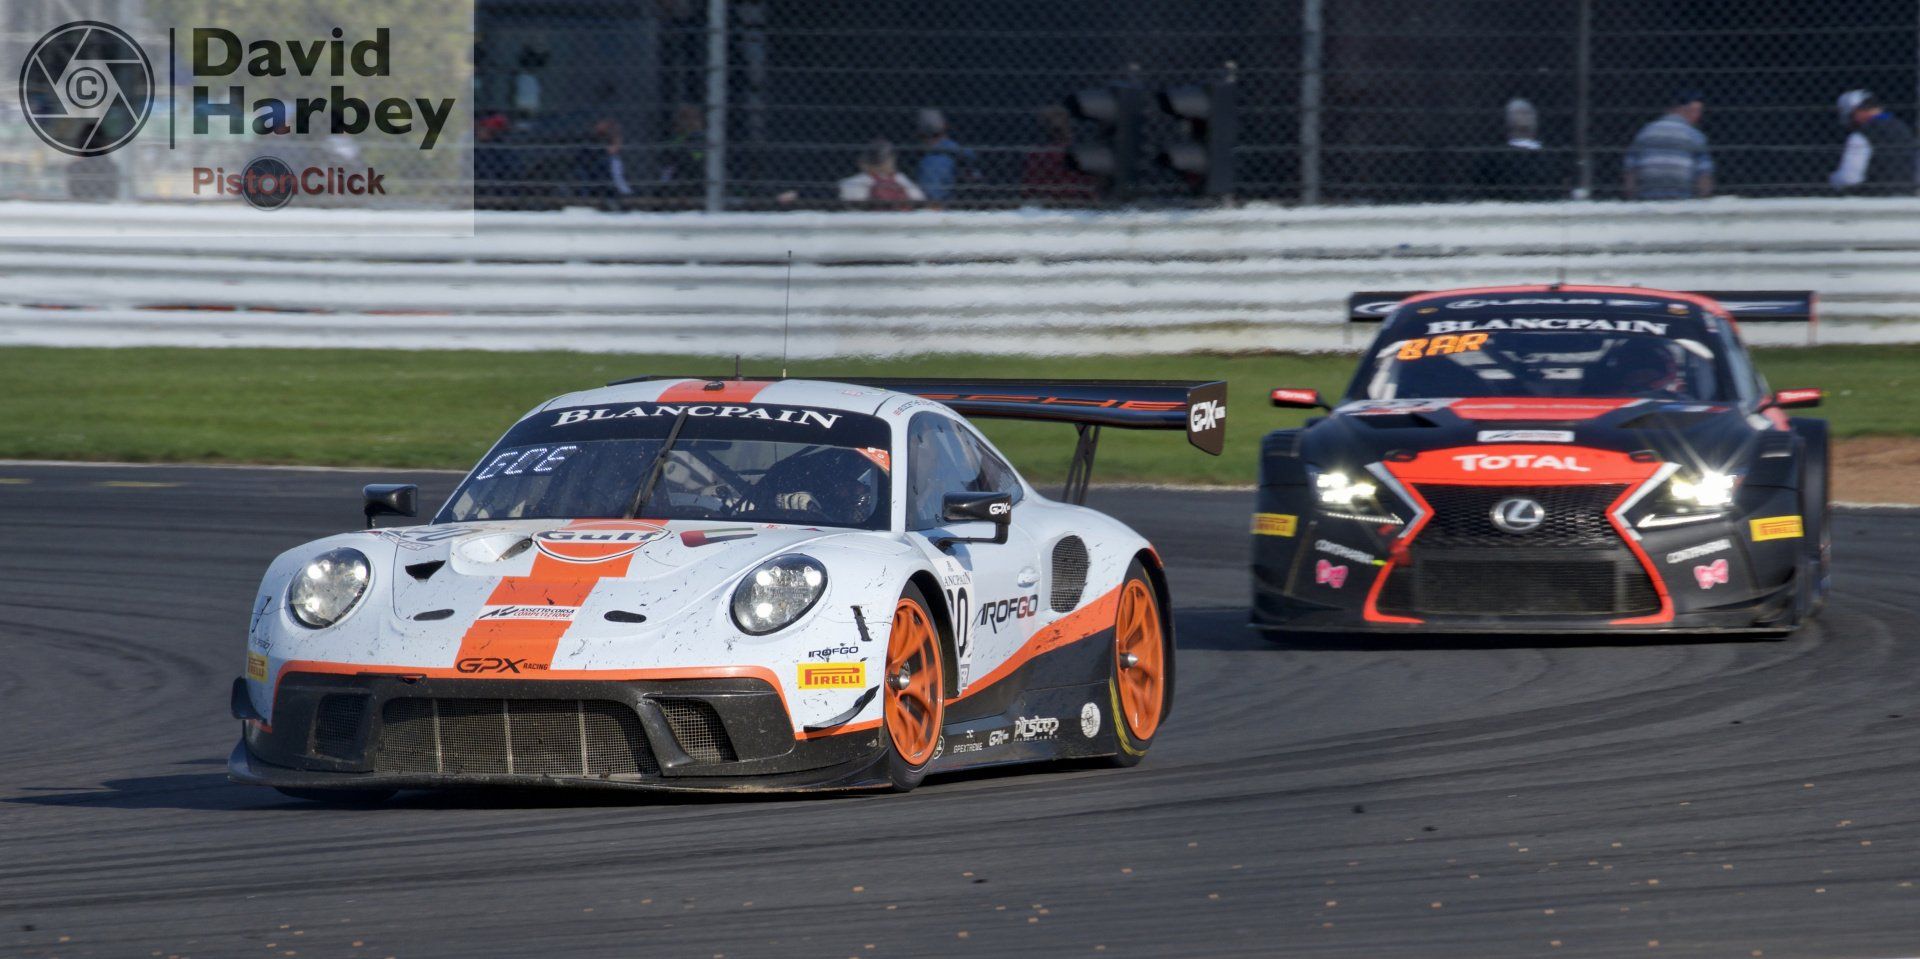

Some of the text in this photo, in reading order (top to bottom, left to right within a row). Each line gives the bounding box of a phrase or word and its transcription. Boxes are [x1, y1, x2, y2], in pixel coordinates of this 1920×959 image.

[1426, 318, 1669, 336] BLANCPAIN
[551, 405, 843, 429] BLANCPAIN
[1190, 400, 1217, 432] GPX
[1452, 454, 1591, 472] TOTAL
[537, 530, 664, 541] Gulf
[944, 571, 971, 587] ANCPAIN
[456, 658, 548, 674] GPX RACING
[804, 667, 861, 685] PIRELLI
